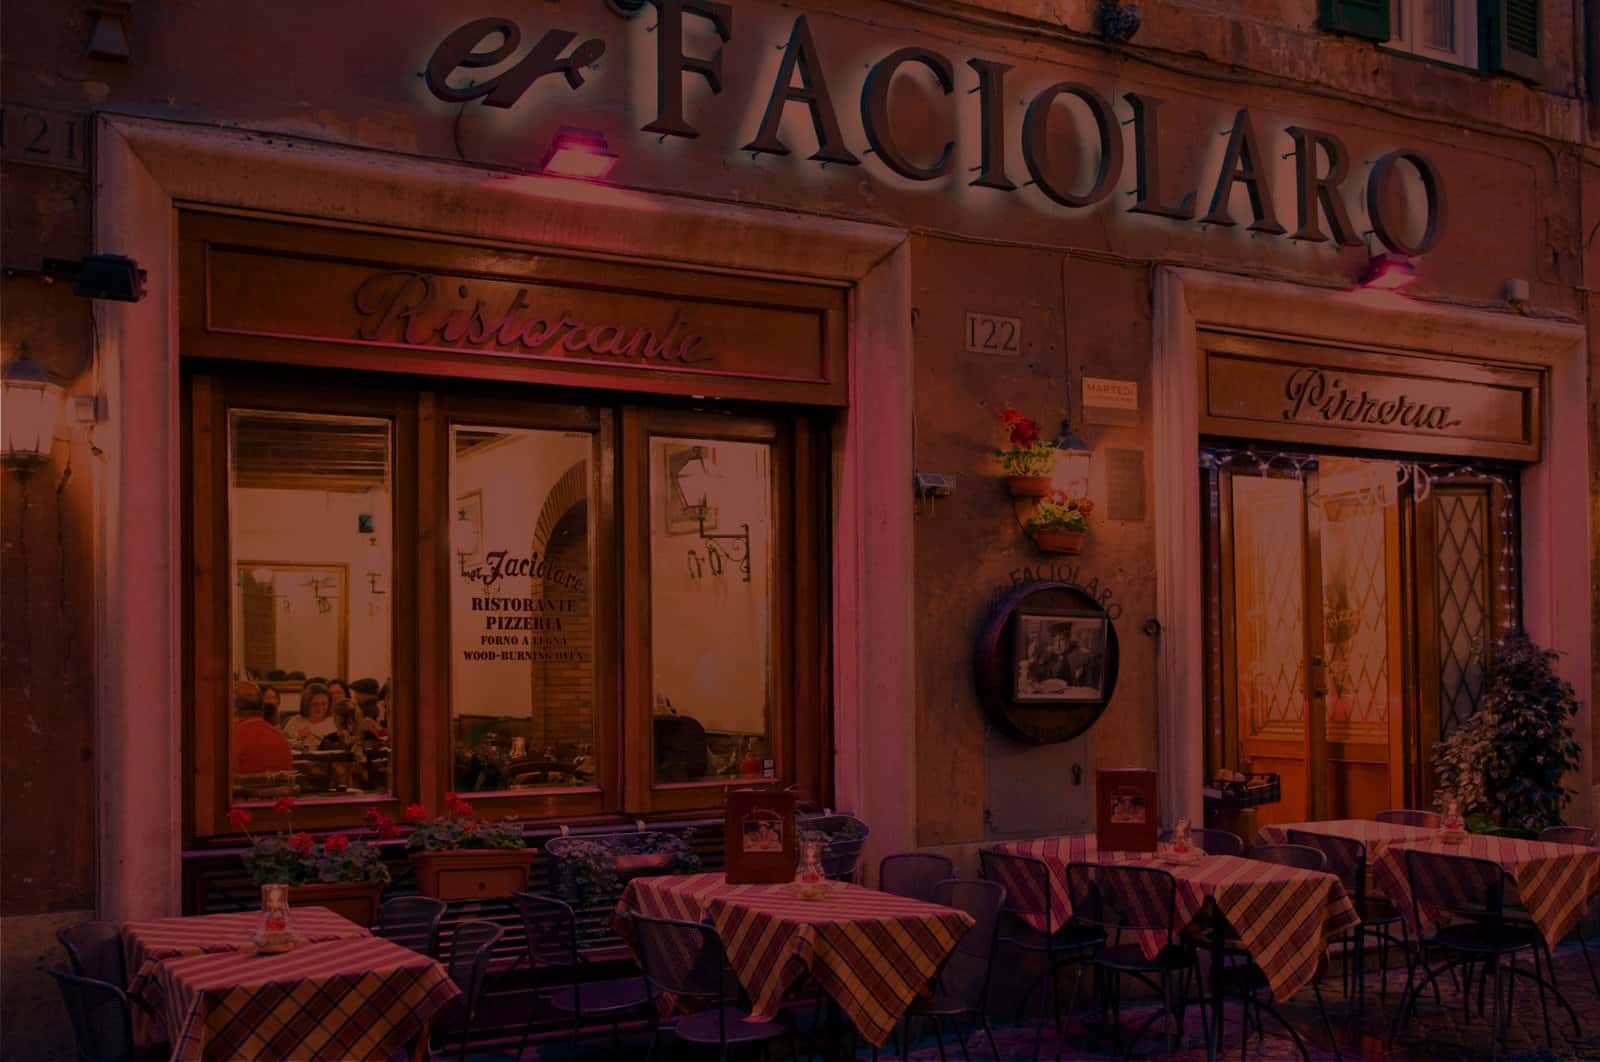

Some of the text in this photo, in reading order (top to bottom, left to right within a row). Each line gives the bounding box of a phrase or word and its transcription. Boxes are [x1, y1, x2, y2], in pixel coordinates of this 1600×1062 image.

[424, 0, 1448, 258] er FACIOLARO
[354, 270, 713, 364] Ristorante
[969, 318, 1017, 351] 122
[471, 597, 576, 612] RISTORANTE
[486, 616, 562, 631] PIZZERIA
[480, 635, 518, 646] FORNO
[521, 636, 529, 645] A
